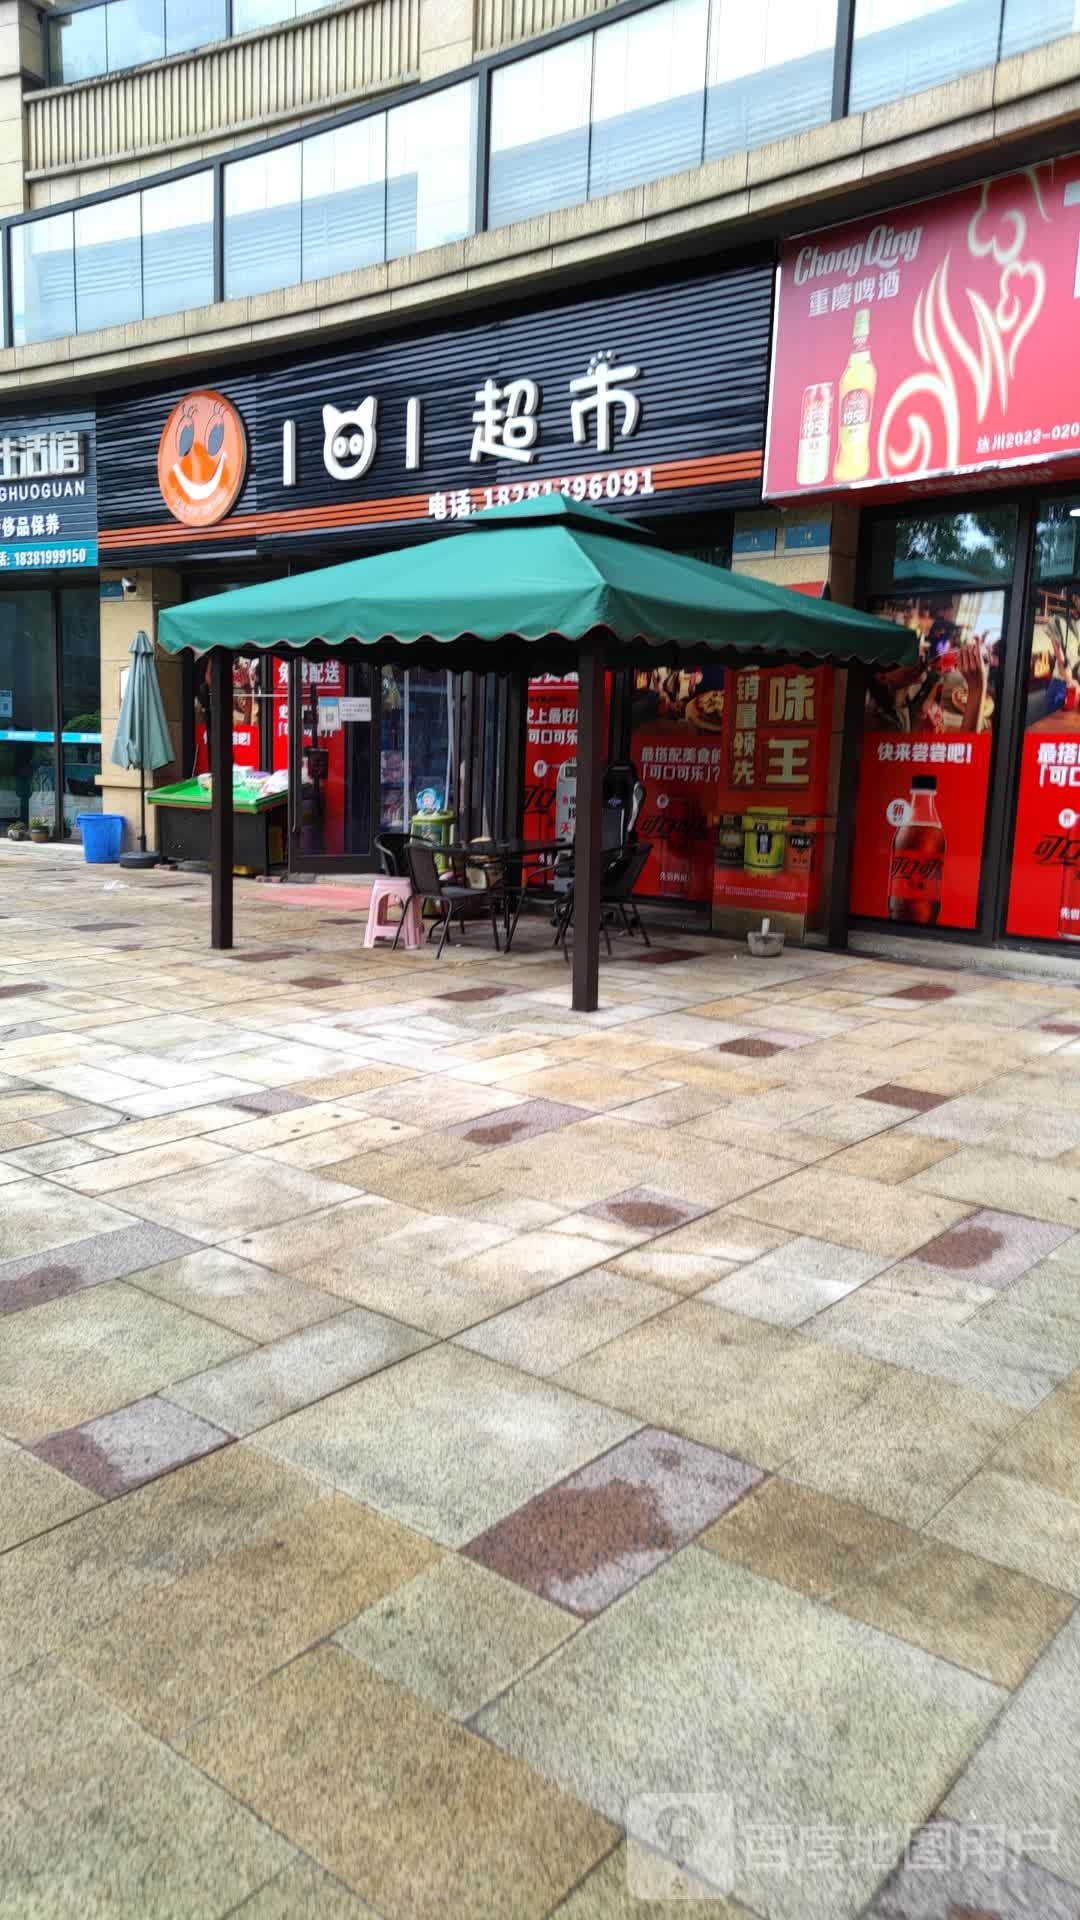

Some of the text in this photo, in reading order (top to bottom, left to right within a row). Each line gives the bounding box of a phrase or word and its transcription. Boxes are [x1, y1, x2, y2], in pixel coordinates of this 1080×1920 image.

[14, 548, 87, 566] 18381999150
[877, 742, 972, 764] 快来尝尝吧!
[1037, 742, 1080, 765] 最搭
